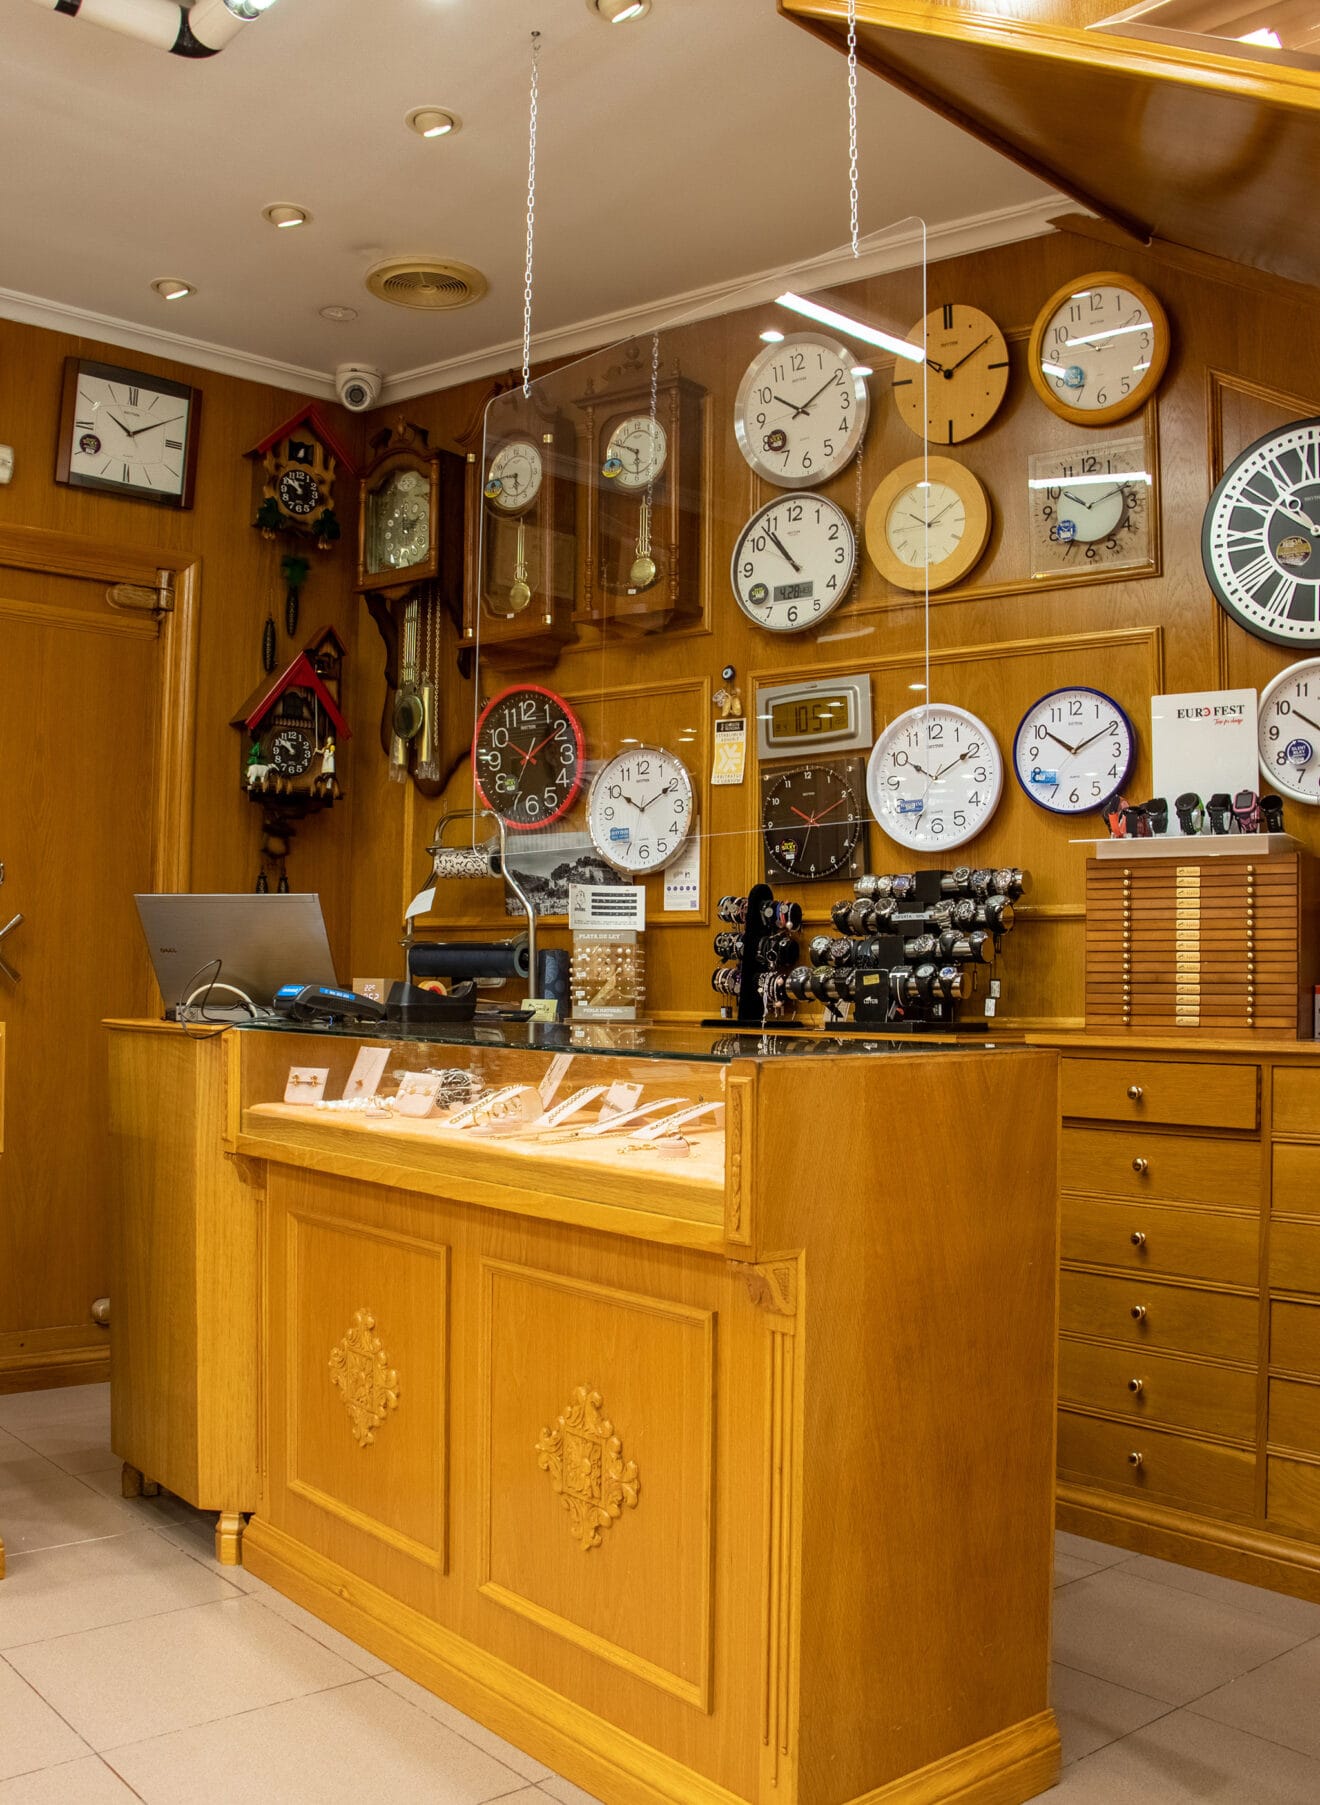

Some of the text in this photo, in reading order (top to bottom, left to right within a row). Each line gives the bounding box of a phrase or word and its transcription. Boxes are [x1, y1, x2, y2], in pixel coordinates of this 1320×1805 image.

[1089, 293, 1103, 311] 12
[1116, 295, 1120, 311] 1
[1069, 305, 1081, 322] 11
[1053, 326, 1068, 344] 10
[1140, 332, 1149, 349] 3
[790, 353, 805, 372] 12
[817, 354, 822, 370] 1
[1050, 350, 1059, 366] 9
[773, 365, 784, 382] 11
[834, 368, 845, 386] 2
[1121, 376, 1130, 394] 5
[758, 387, 772, 404] 10
[840, 392, 850, 409] 3
[1075, 385, 1084, 402] 7
[1097, 386, 1106, 404] 6
[757, 412, 766, 429] 9
[839, 416, 848, 432] 4
[824, 439, 834, 456] 5
[781, 450, 790, 467] 7
[802, 452, 812, 468] 6
[1082, 457, 1096, 473] 12
[1126, 493, 1137, 509] 3
[786, 506, 803, 522] 12
[815, 508, 819, 524] 1
[1043, 506, 1052, 522] 9
[766, 516, 777, 532] 11
[1122, 516, 1132, 530] 4
[828, 524, 838, 540] 2
[750, 536, 766, 552] 10
[1106, 533, 1116, 549] 5
[835, 547, 844, 563] 3
[1086, 543, 1095, 558] 6
[744, 562, 753, 578] 9
[826, 575, 837, 590] 4
[766, 607, 773, 618] 7
[814, 600, 820, 611] 5
[788, 606, 797, 622] 6
[1296, 683, 1308, 697] 11
[519, 700, 536, 720] 12
[544, 704, 550, 724] 1
[1051, 708, 1061, 722] 11
[1068, 700, 1082, 716] 12
[1095, 705, 1099, 719] 1
[1276, 700, 1290, 715] 10
[504, 708, 516, 728] 11
[554, 720, 567, 740] 2
[928, 724, 943, 740] 12
[954, 727, 959, 742] 1
[1034, 724, 1047, 740] 10
[1109, 720, 1119, 736] 2
[1269, 726, 1279, 740] 9
[490, 728, 508, 748] 10
[907, 732, 918, 747] 11
[560, 744, 574, 764] 3
[968, 743, 980, 758] 2
[1030, 746, 1039, 761] 9
[1112, 742, 1121, 757] 3
[488, 751, 501, 771] 9
[892, 751, 908, 766] 10
[1276, 751, 1286, 765] 8
[620, 768, 630, 781] 11
[636, 761, 650, 775] 12
[659, 764, 663, 778] 1
[974, 767, 986, 782] 3
[1108, 764, 1118, 778] 4
[1296, 769, 1305, 783] 7
[555, 768, 570, 788] 4
[669, 778, 678, 792] 2
[887, 776, 900, 791] 9
[608, 785, 621, 799] 10
[1050, 784, 1059, 799] 7
[1069, 788, 1079, 803] 6
[1091, 781, 1100, 796] 5
[526, 795, 539, 815] 6
[544, 787, 558, 807] 5
[968, 791, 981, 806] 4
[604, 807, 614, 820] 9
[674, 799, 684, 813] 3
[914, 814, 922, 830] 7
[931, 818, 944, 834] 6
[953, 810, 965, 826] 5
[669, 821, 678, 835] 4
[639, 845, 649, 859] 6
[657, 838, 667, 852] 5
